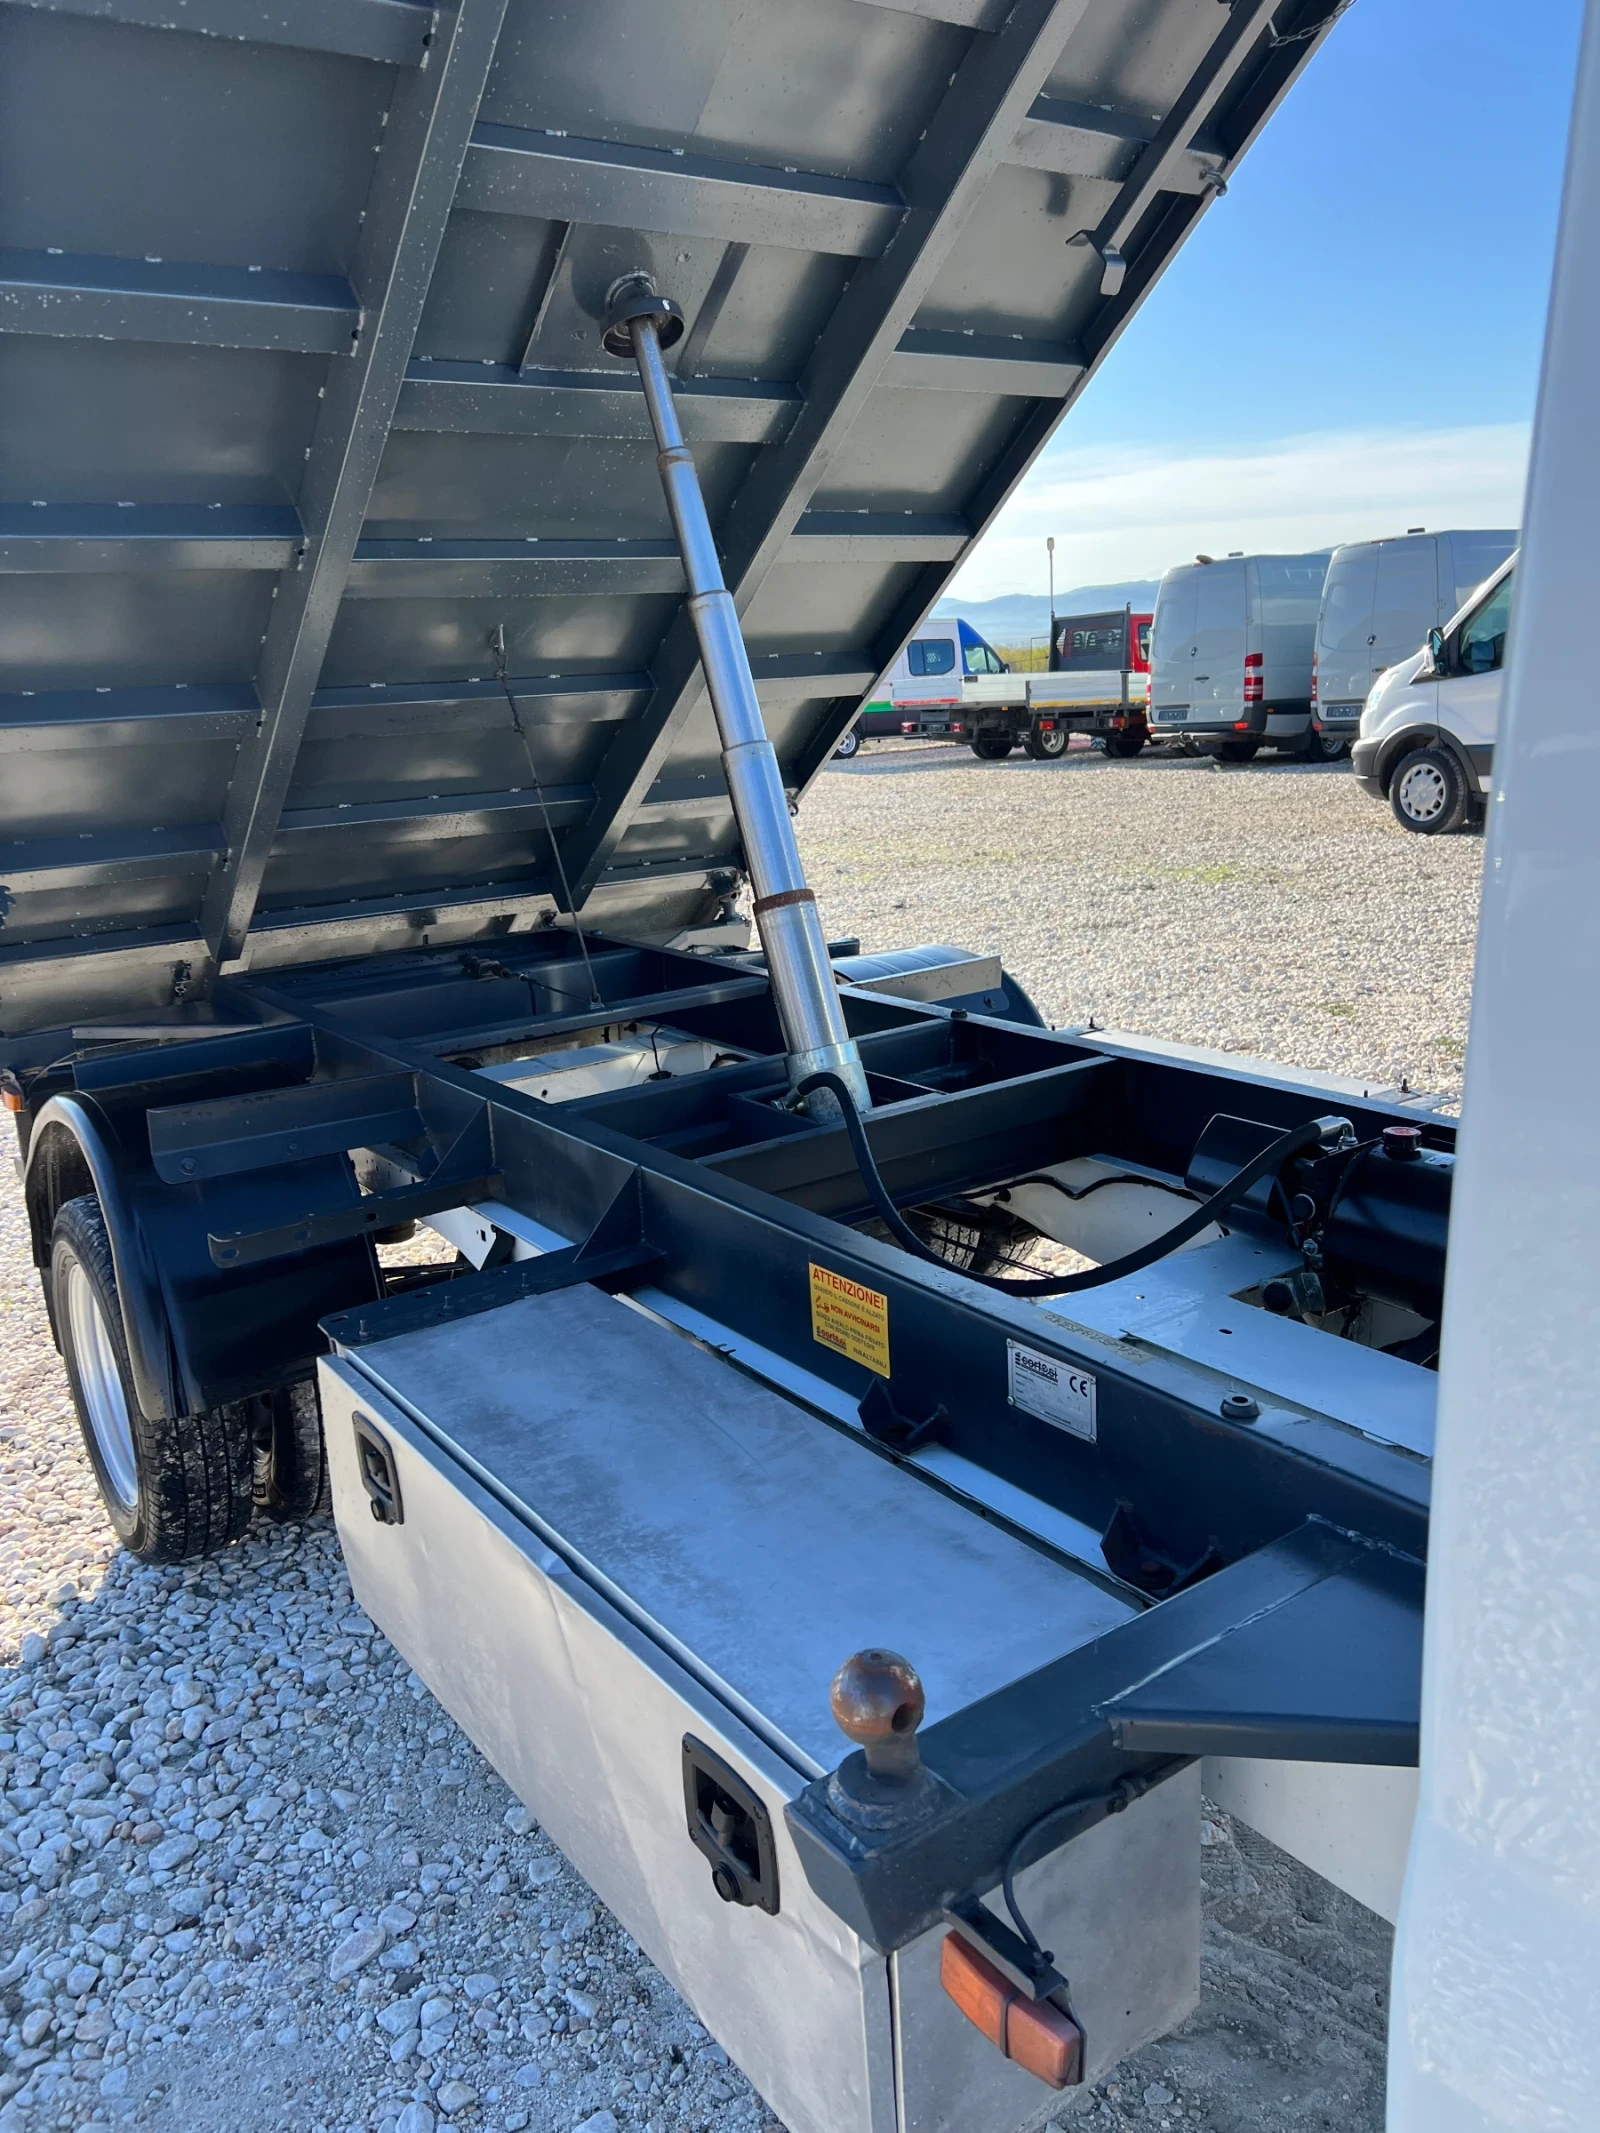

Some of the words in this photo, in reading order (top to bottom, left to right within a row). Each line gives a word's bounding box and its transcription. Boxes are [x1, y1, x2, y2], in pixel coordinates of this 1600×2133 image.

[813, 1268, 884, 1310] ATTENZIONE!
[830, 1304, 844, 1317] NON
[844, 1310, 880, 1333] AVVICINARSI
[838, 1296, 861, 1311] CASSONE
[865, 1308, 885, 1321] ALZATO
[853, 1347, 887, 1369] RIBALTABILI
[1069, 1375, 1088, 1398] CE
